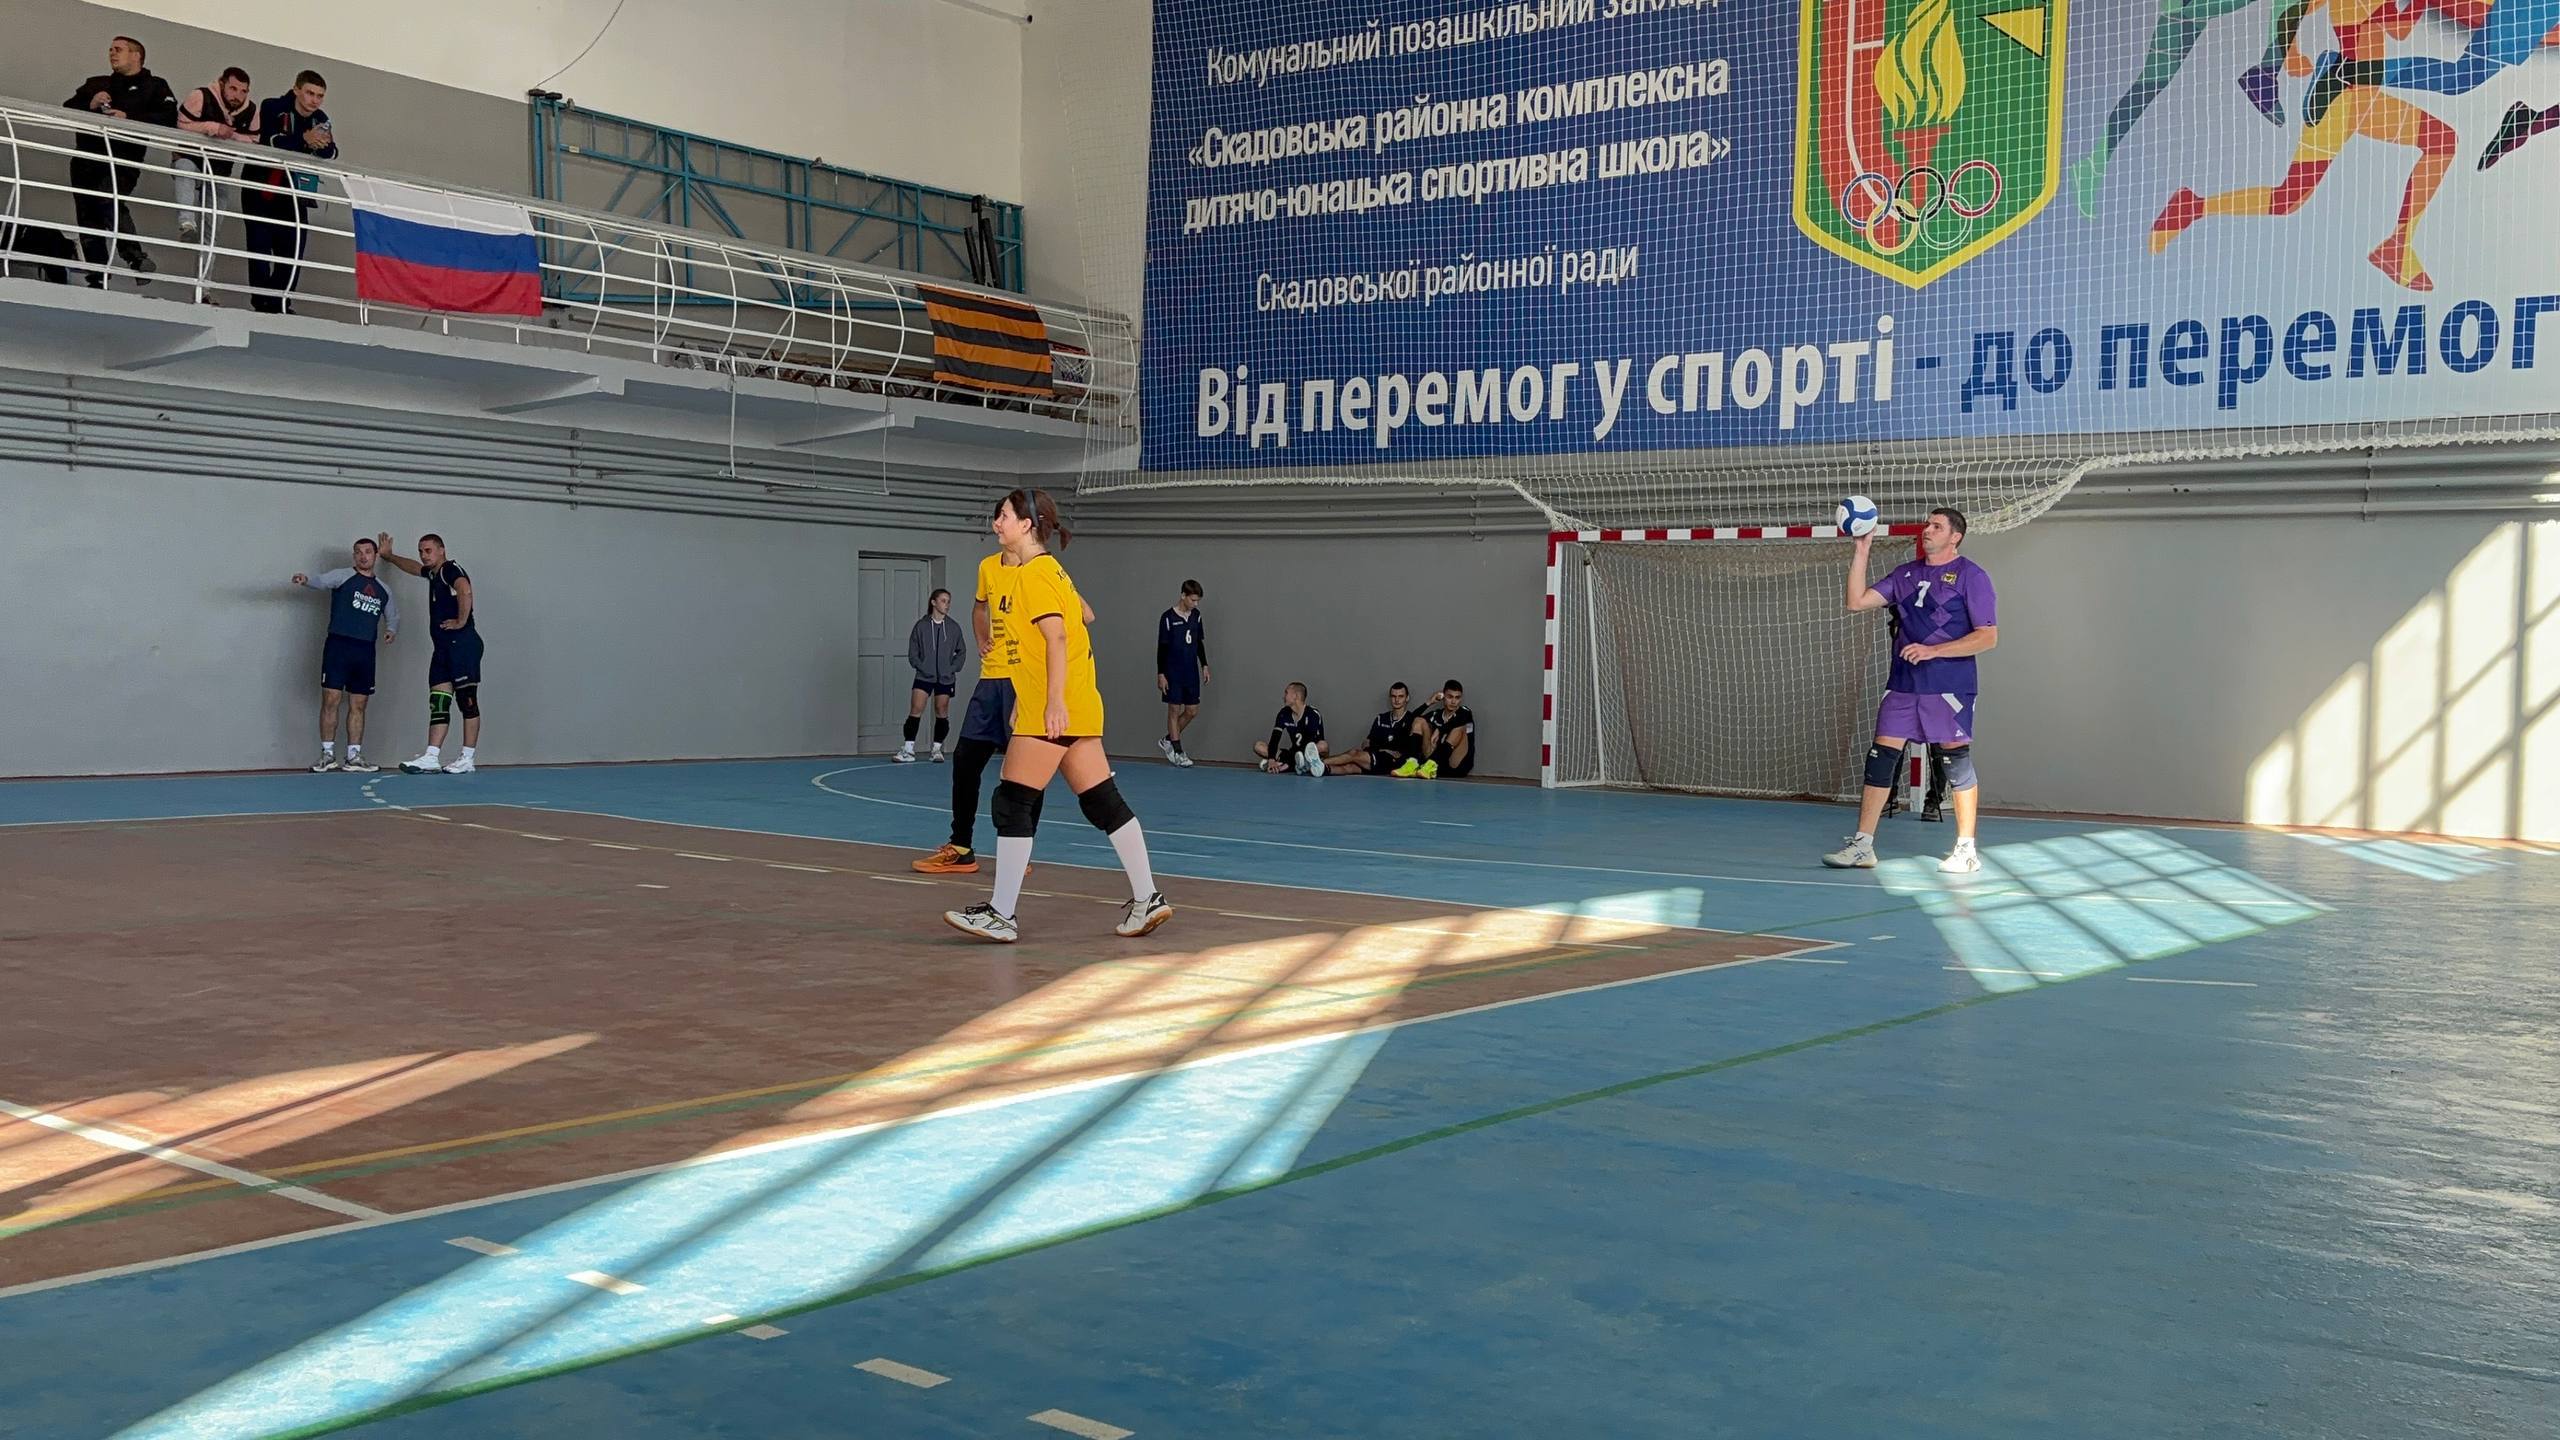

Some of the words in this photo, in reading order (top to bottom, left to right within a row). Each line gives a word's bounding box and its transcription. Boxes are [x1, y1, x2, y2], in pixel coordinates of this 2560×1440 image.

[1207, 19, 1381, 87] Комунальний
[1188, 115, 1366, 168] «Скадовська
[1375, 93, 1507, 154] районна
[1516, 58, 1729, 124] комплексна
[1183, 171, 1412, 235] дитячо-юнацька
[1421, 147, 1588, 205] спортивна
[1598, 130, 1731, 179] школа»
[1256, 259, 1420, 315] Скадовської
[1424, 245, 1556, 307] районної
[1561, 245, 1639, 294] ради
[1198, 363, 1288, 449] Від
[1302, 362, 1579, 449] перемог
[1594, 358, 1633, 442] у
[1647, 314, 1894, 430] спорті
[1960, 327, 2073, 413] до
[2098, 295, 2560, 411] перемог
[361, 602, 380, 615] UFC
[1914, 580, 1932, 608] 7
[1185, 629, 1192, 644] 6
